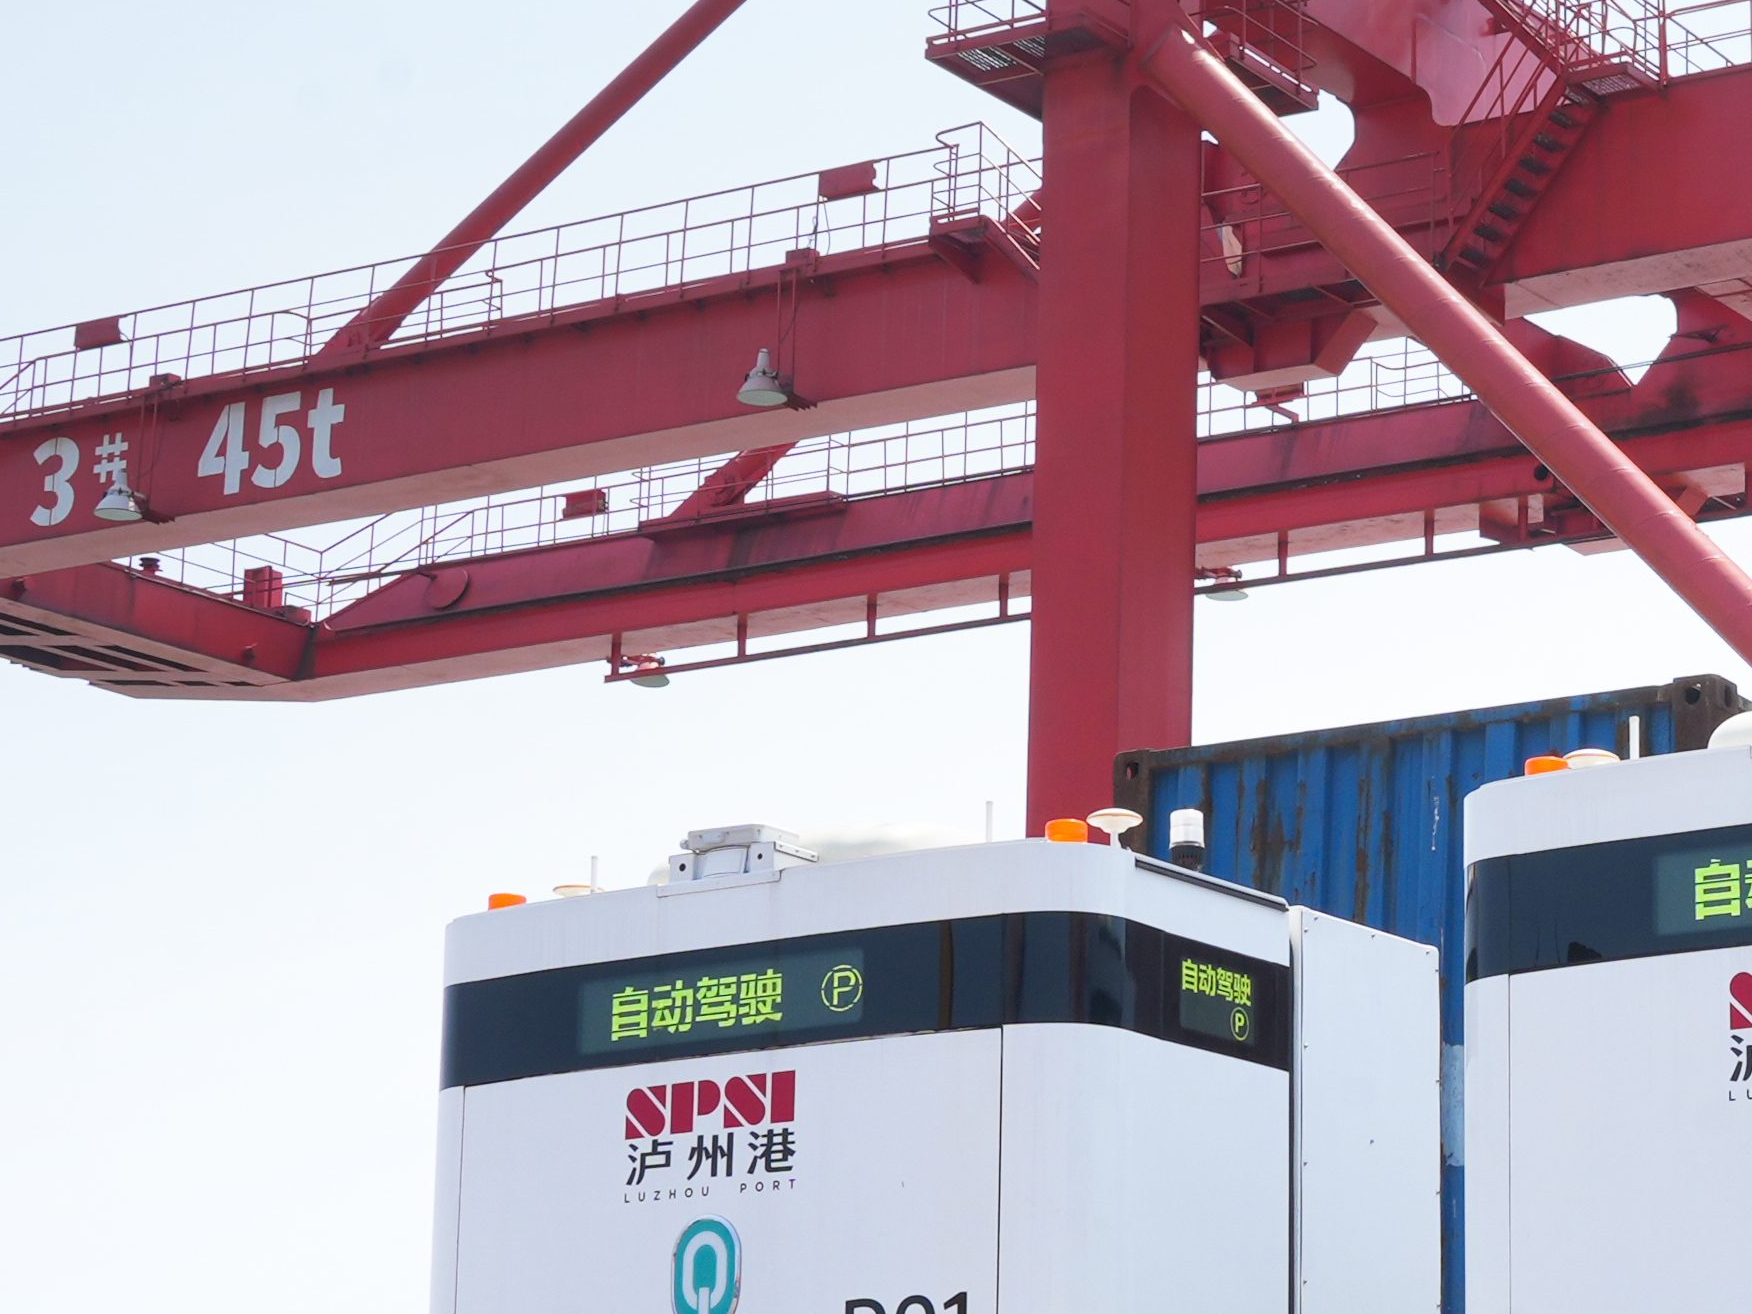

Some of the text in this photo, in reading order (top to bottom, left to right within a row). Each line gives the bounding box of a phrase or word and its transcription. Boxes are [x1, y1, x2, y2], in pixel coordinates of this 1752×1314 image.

[197, 388, 346, 496] 45t
[611, 968, 783, 1041] 自动驾驶
[1182, 958, 1252, 1006] 自动驾驶
[625, 1070, 796, 1140] SPSI
[626, 1127, 796, 1185] 泸州港
[624, 1178, 796, 1203] LUZHOU PORT
